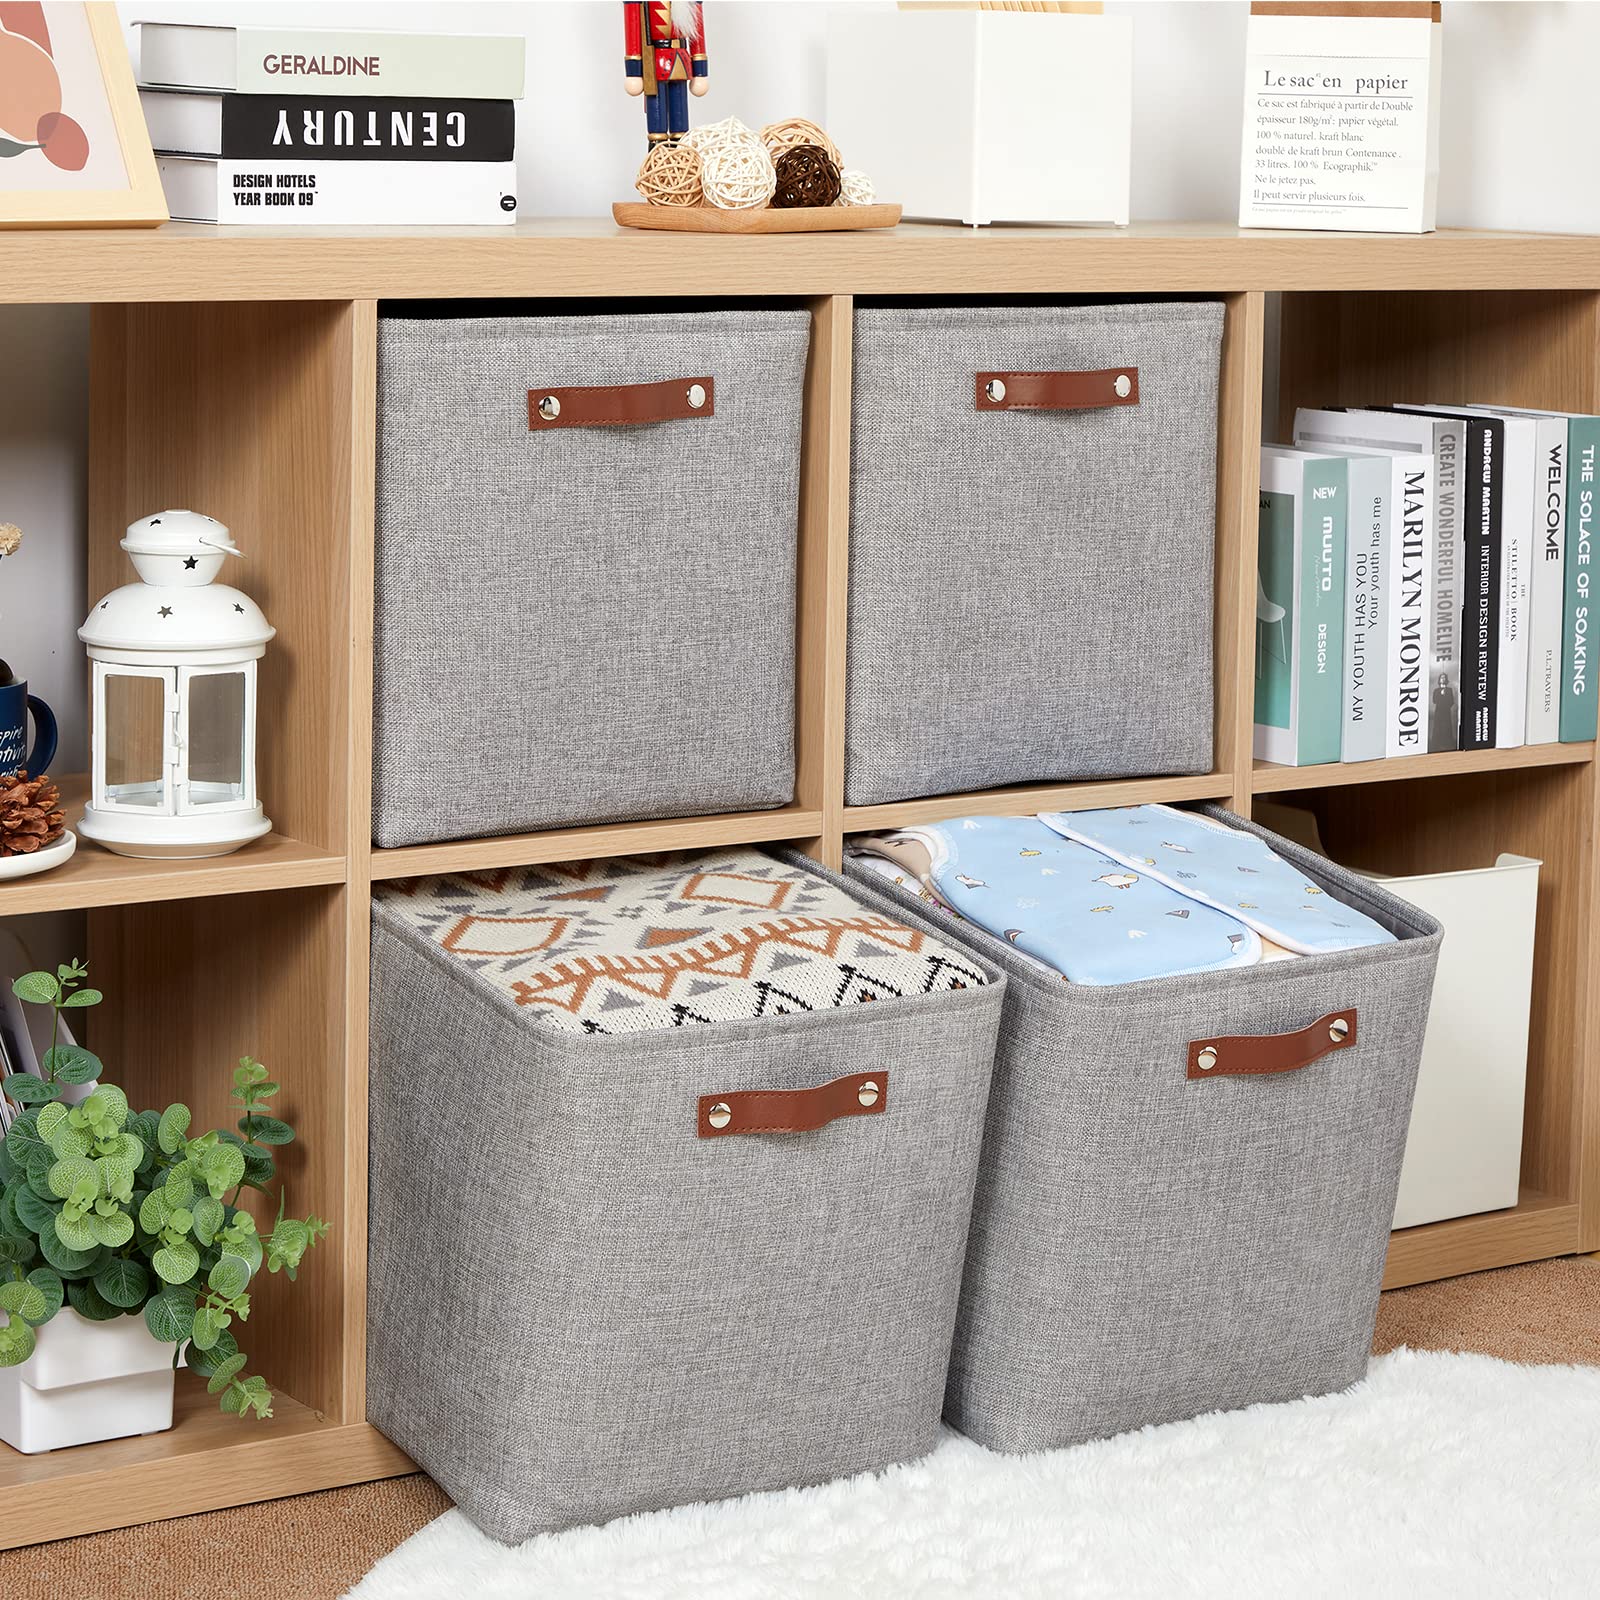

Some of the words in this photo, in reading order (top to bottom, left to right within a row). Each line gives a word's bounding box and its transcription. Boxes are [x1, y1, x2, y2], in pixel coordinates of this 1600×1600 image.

[263, 54, 380, 76] GERALDINE
[1264, 70, 1286, 87] Le
[1290, 76, 1315, 87] sac
[1322, 77, 1342, 88] en
[1355, 74, 1408, 94] papier
[1257, 98, 1270, 108] Ce
[1271, 100, 1285, 108] sac
[1286, 100, 1298, 108] est
[1300, 98, 1336, 111] fabriqué
[1337, 101, 1343, 109] à
[1344, 101, 1369, 112] partir
[1369, 100, 1381, 110] de
[1381, 101, 1414, 111] Double
[1257, 115, 1296, 126] épaisseur
[1338, 116, 1365, 127] papier
[1367, 116, 1399, 129] végétal.
[272, 109, 466, 146] CENTURY
[1256, 130, 1272, 139] 100
[1273, 130, 1282, 139] %
[1319, 131, 1339, 141] kraft
[1341, 131, 1364, 142] blanc
[1255, 159, 1266, 168] 33
[1293, 160, 1309, 169] 100
[1309, 160, 1319, 169] %
[1287, 146, 1299, 155] de
[1299, 146, 1320, 156] kraft
[1321, 147, 1343, 156] brun
[233, 174, 273, 188] DESIGN
[276, 174, 316, 188] HOTELS
[1253, 188, 1260, 198] Il
[1261, 191, 1281, 201] peut
[1282, 191, 1307, 200] servir
[1308, 191, 1347, 203] plusieurs
[1254, 174, 1268, 183] Ne
[1269, 174, 1277, 184] le
[1278, 175, 1298, 186] jetez
[233, 192, 261, 206] YEAR
[265, 192, 295, 206] BOOK
[298, 192, 314, 206] 09
[1439, 434, 1456, 487] CREATE
[1482, 429, 1493, 484] ANDREW
[1581, 445, 1595, 483] THE
[1313, 486, 1337, 500] NEW
[1373, 496, 1382, 518] me
[1546, 443, 1562, 561] WELCOME
[1481, 486, 1491, 536] MARTIN
[1578, 490, 1593, 565] SOLACE
[1370, 522, 1381, 547] has
[1401, 470, 1425, 608] MARILYN
[1437, 491, 1455, 585] WONDERFUL
[1355, 553, 1368, 589] YOU
[1370, 552, 1381, 591] youth
[1480, 544, 1490, 595] INTERIOR
[1577, 572, 1590, 599] OF
[1355, 593, 1367, 627] HAS
[1368, 596, 1379, 629] Your
[1436, 589, 1453, 662] HOMELIFE
[1478, 598, 1489, 648] DESIGN
[1510, 607, 1518, 642] BOOK
[1317, 623, 1327, 674] DESIGN
[1353, 633, 1365, 690] YOUTH
[1572, 607, 1588, 696] SOAKING
[1398, 616, 1422, 747] MONROE
[1352, 695, 1364, 721] MY
